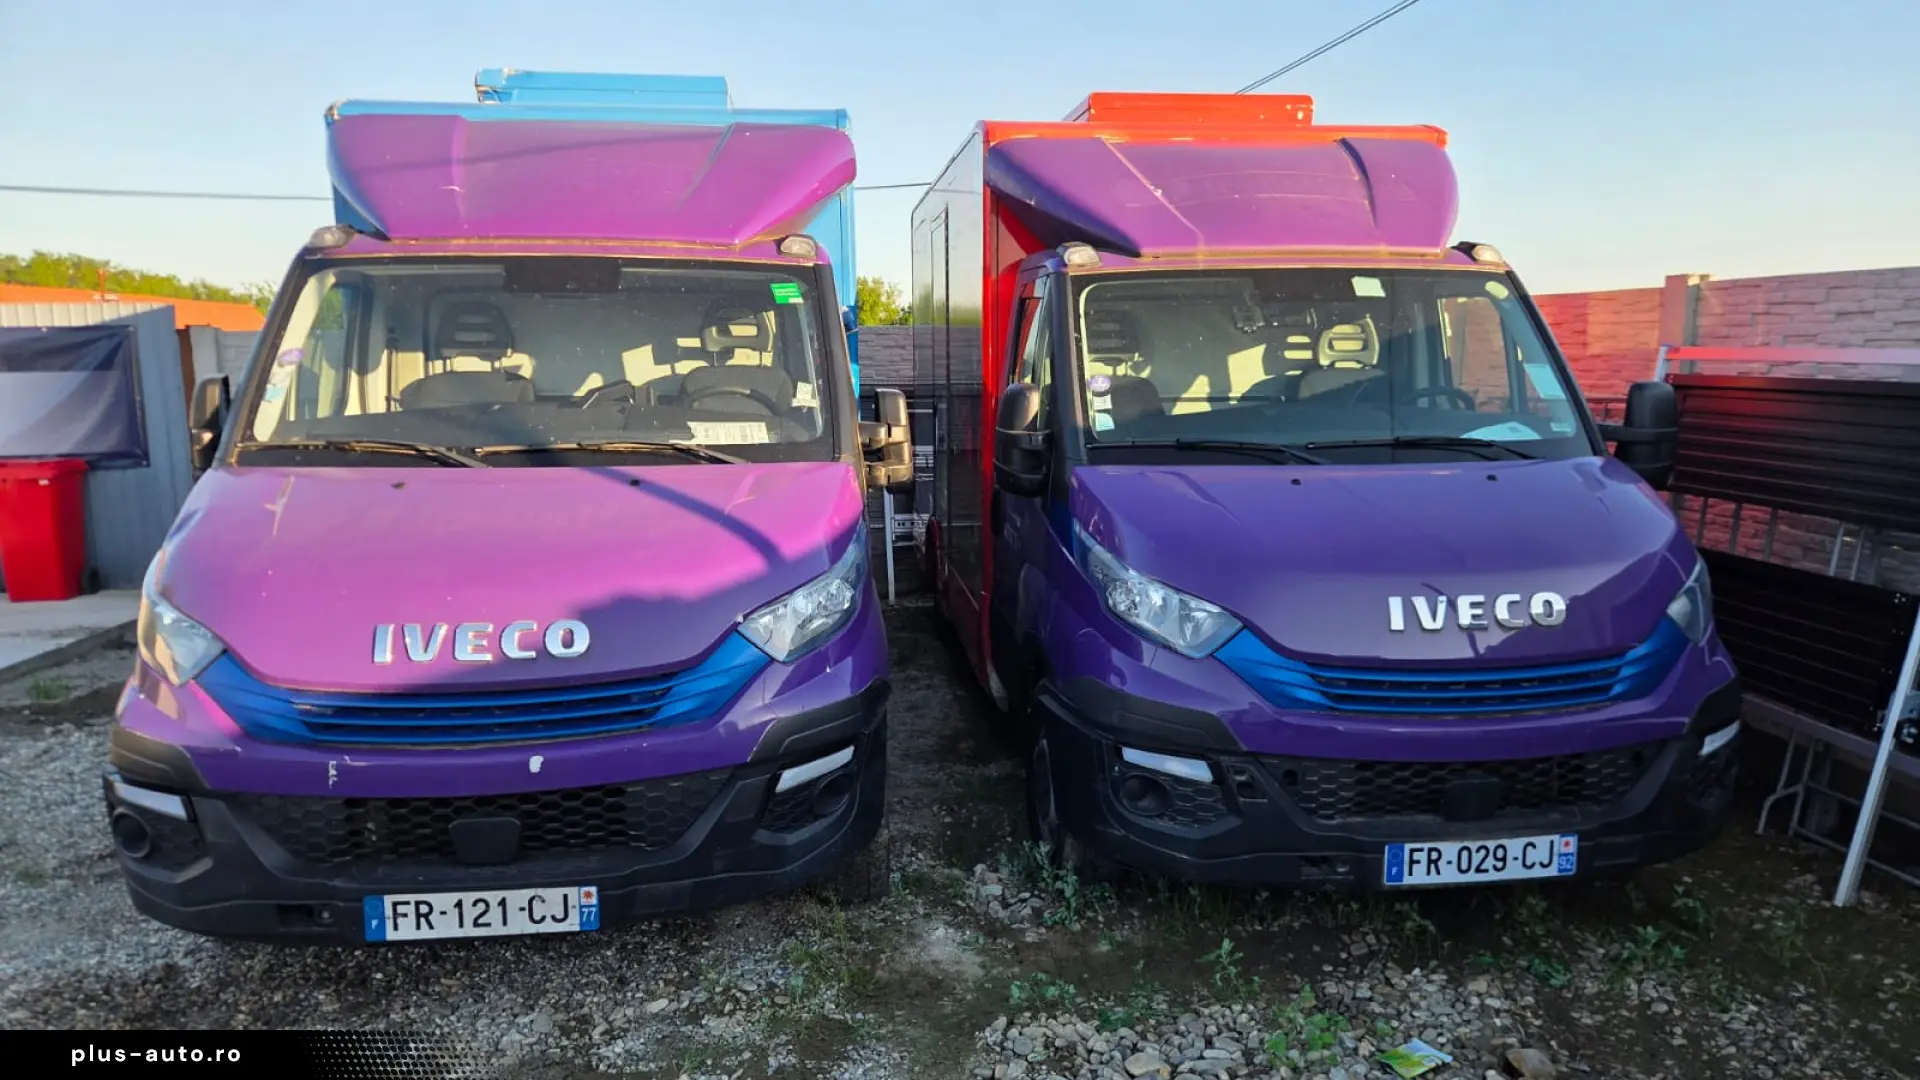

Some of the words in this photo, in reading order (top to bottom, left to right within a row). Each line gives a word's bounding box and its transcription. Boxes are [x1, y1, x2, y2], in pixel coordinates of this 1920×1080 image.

[1388, 591, 1567, 631] IVECO
[373, 618, 591, 664] IVECO
[1407, 840, 1555, 877] FR-029-CJ
[1558, 857, 1574, 870] 92
[391, 893, 570, 932] FR-121-CJ
[581, 907, 597, 922] 77
